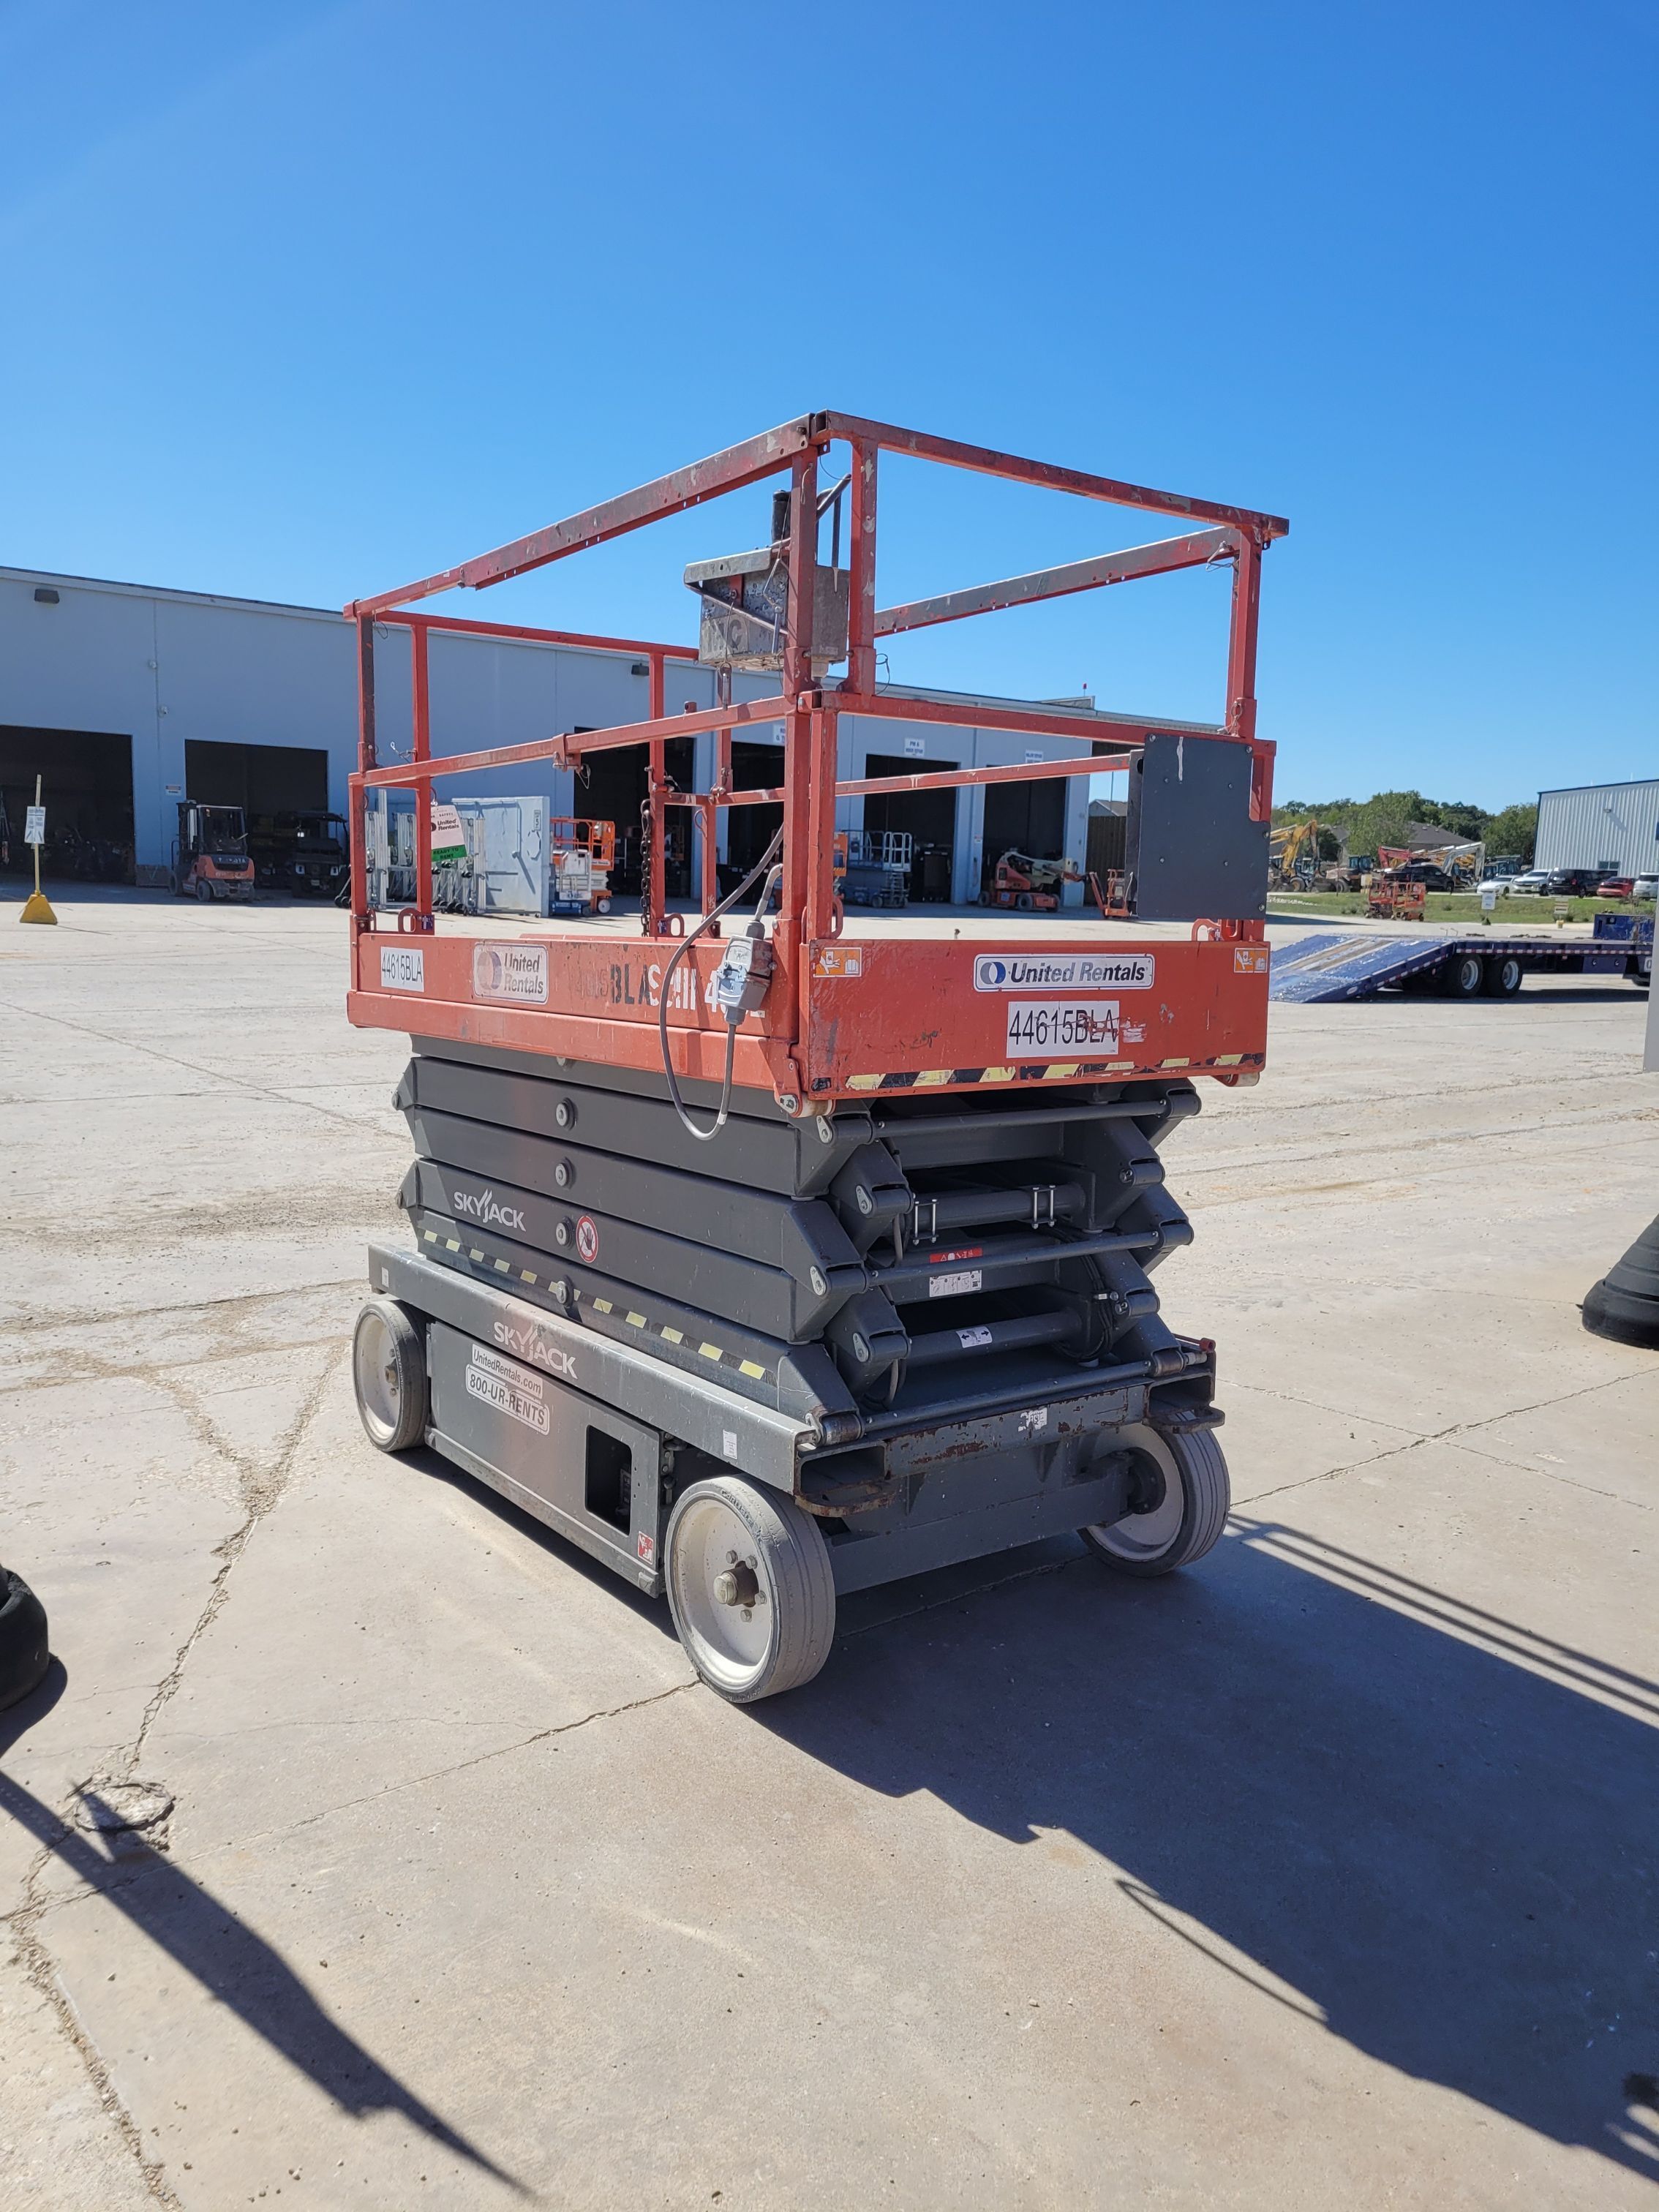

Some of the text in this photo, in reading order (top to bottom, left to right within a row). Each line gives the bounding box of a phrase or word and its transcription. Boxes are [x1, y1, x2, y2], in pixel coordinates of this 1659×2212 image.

[382, 952, 423, 983] 44615BLA
[504, 952, 541, 973] United
[1010, 961, 1146, 983] United Rentals
[503, 971, 544, 995] Rentals
[1009, 1009, 1118, 1045] 44615BLA
[454, 1189, 527, 1232] SKYJACK
[494, 1321, 578, 1380] SKYJACK
[474, 1349, 541, 1395] UnitedRentals.com
[470, 1374, 545, 1426] 800-UR-RENTS
